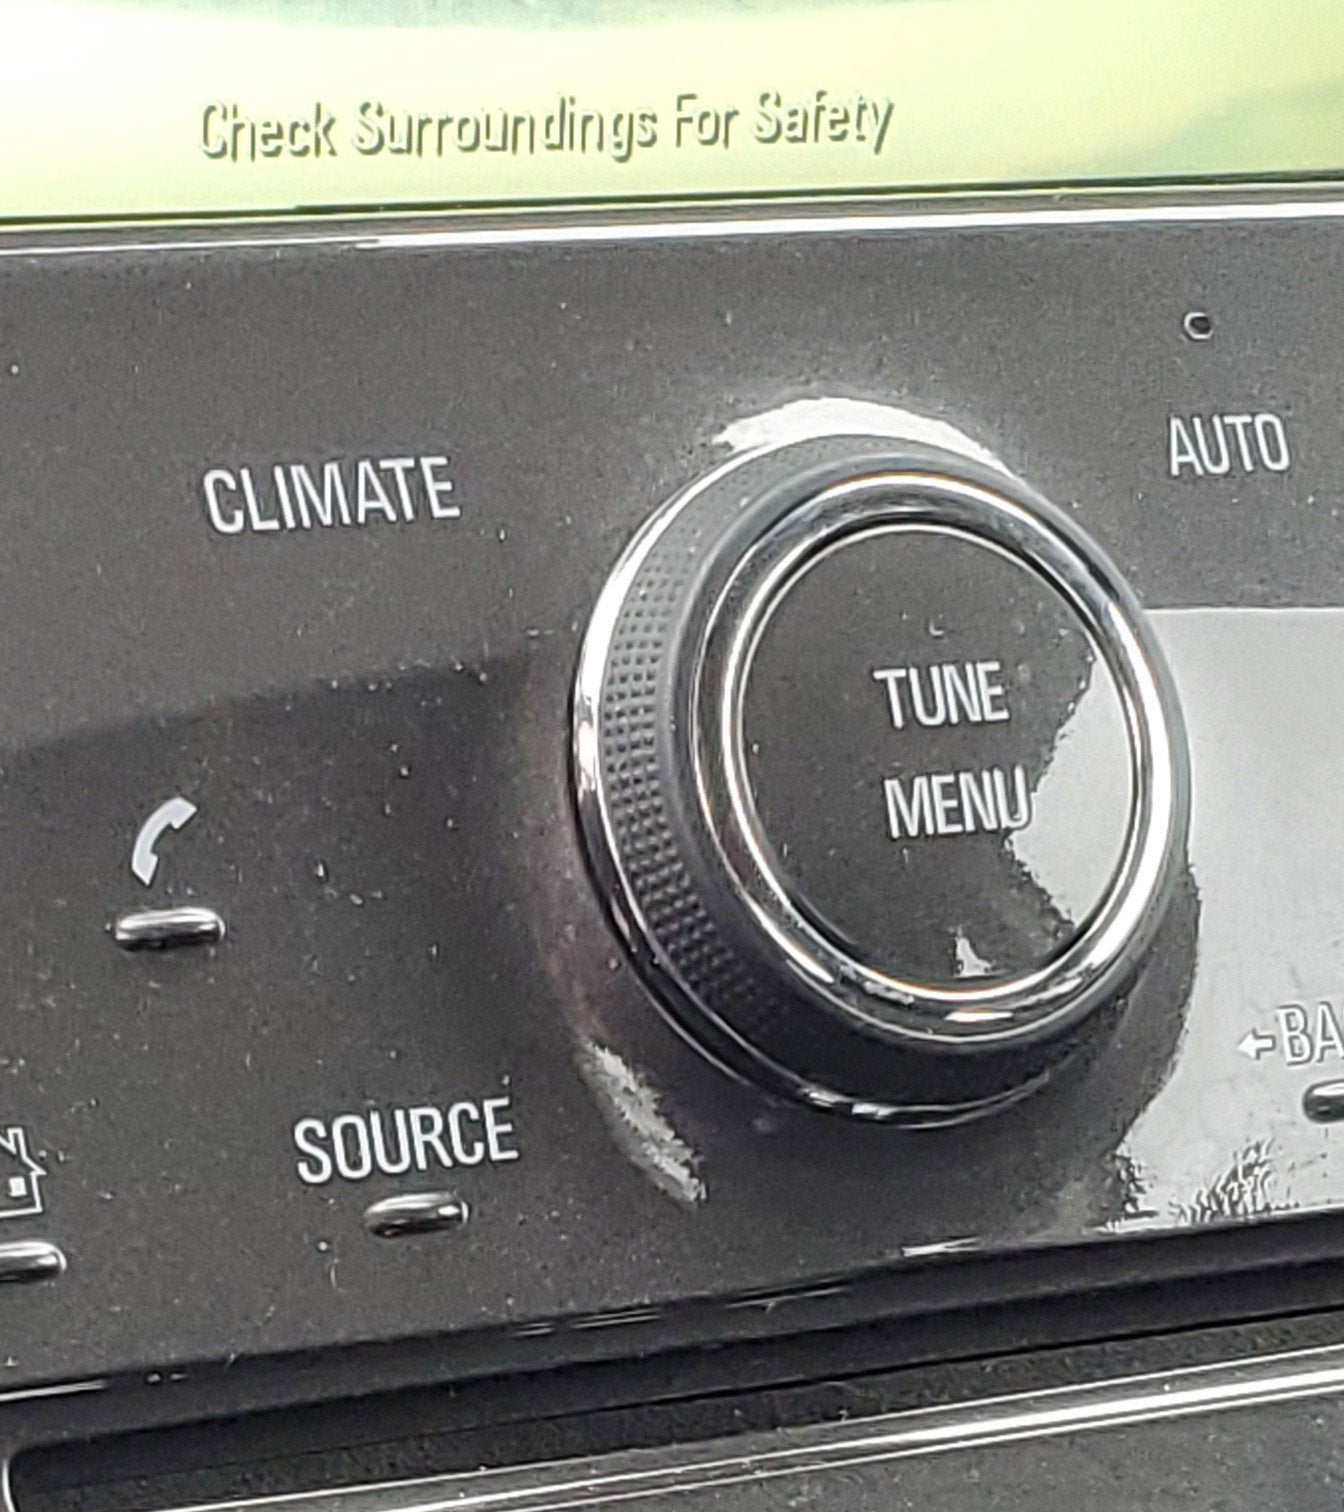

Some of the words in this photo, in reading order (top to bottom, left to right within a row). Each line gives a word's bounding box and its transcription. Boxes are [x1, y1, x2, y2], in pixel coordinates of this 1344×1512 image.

[199, 101, 336, 162] Check
[351, 92, 657, 163] Surroundings
[674, 92, 738, 149] For
[752, 88, 894, 153] Safety
[1168, 413, 1290, 476] AUTO
[203, 455, 460, 536] CLIMATE
[873, 662, 1011, 730] TUNE
[883, 766, 1033, 841] MENU
[293, 1097, 519, 1185] SOURCE
